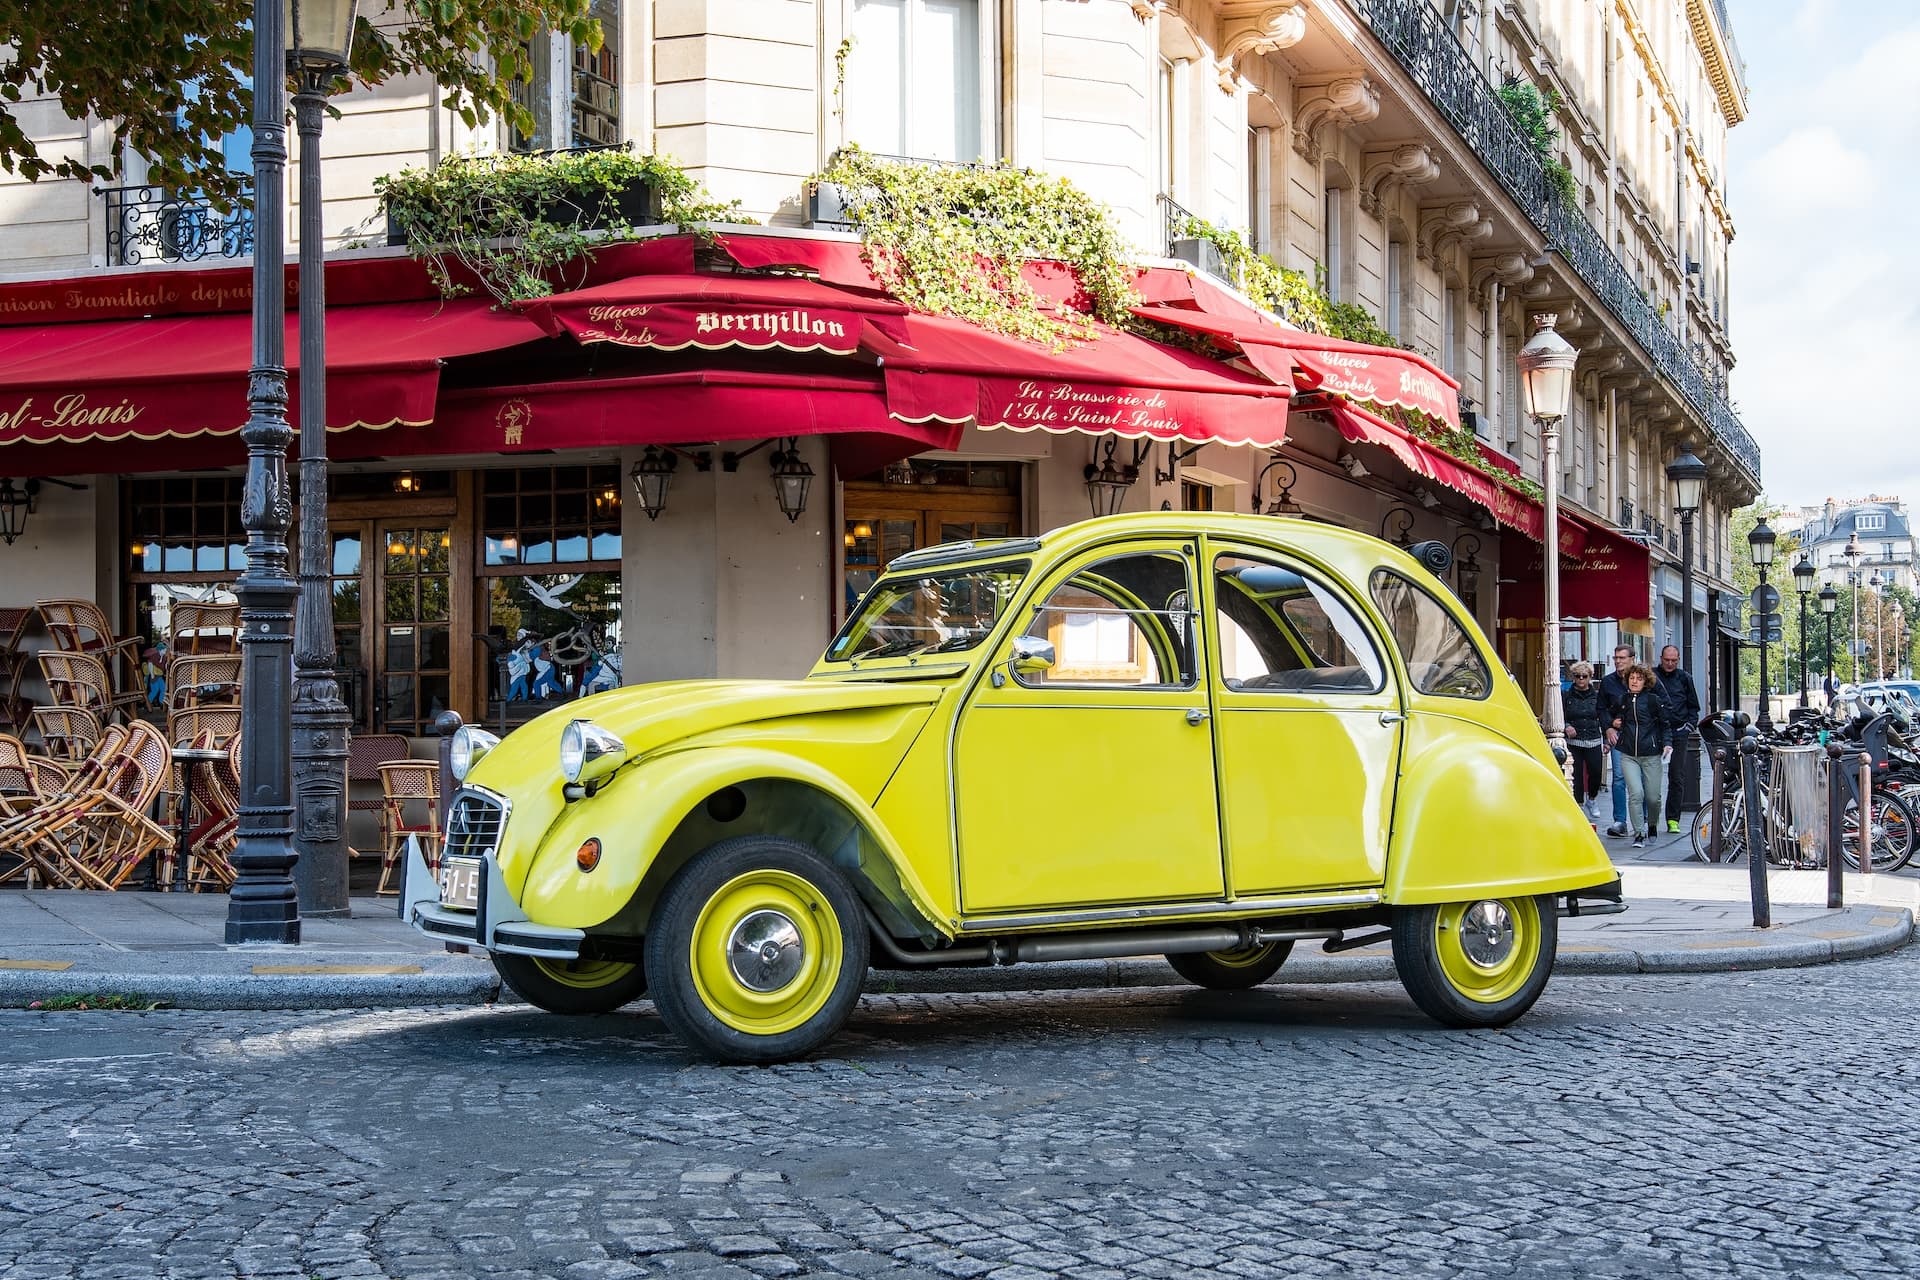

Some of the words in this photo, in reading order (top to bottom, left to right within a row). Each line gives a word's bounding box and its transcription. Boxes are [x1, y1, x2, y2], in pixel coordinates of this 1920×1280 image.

[65, 284, 179, 309] Familiale
[191, 283, 253, 308] depui
[588, 305, 653, 322] Glaces
[614, 319, 624, 331] &
[695, 310, 845, 337] Berthillon
[1319, 350, 1371, 369] Glaces
[1015, 380, 1043, 399] La
[1049, 383, 1142, 407] Brasserie
[1144, 392, 1168, 409] de
[1325, 373, 1378, 394] Sorbets
[1002, 402, 1058, 421] l'Isle
[1063, 405, 1183, 431] Saint-Louis
